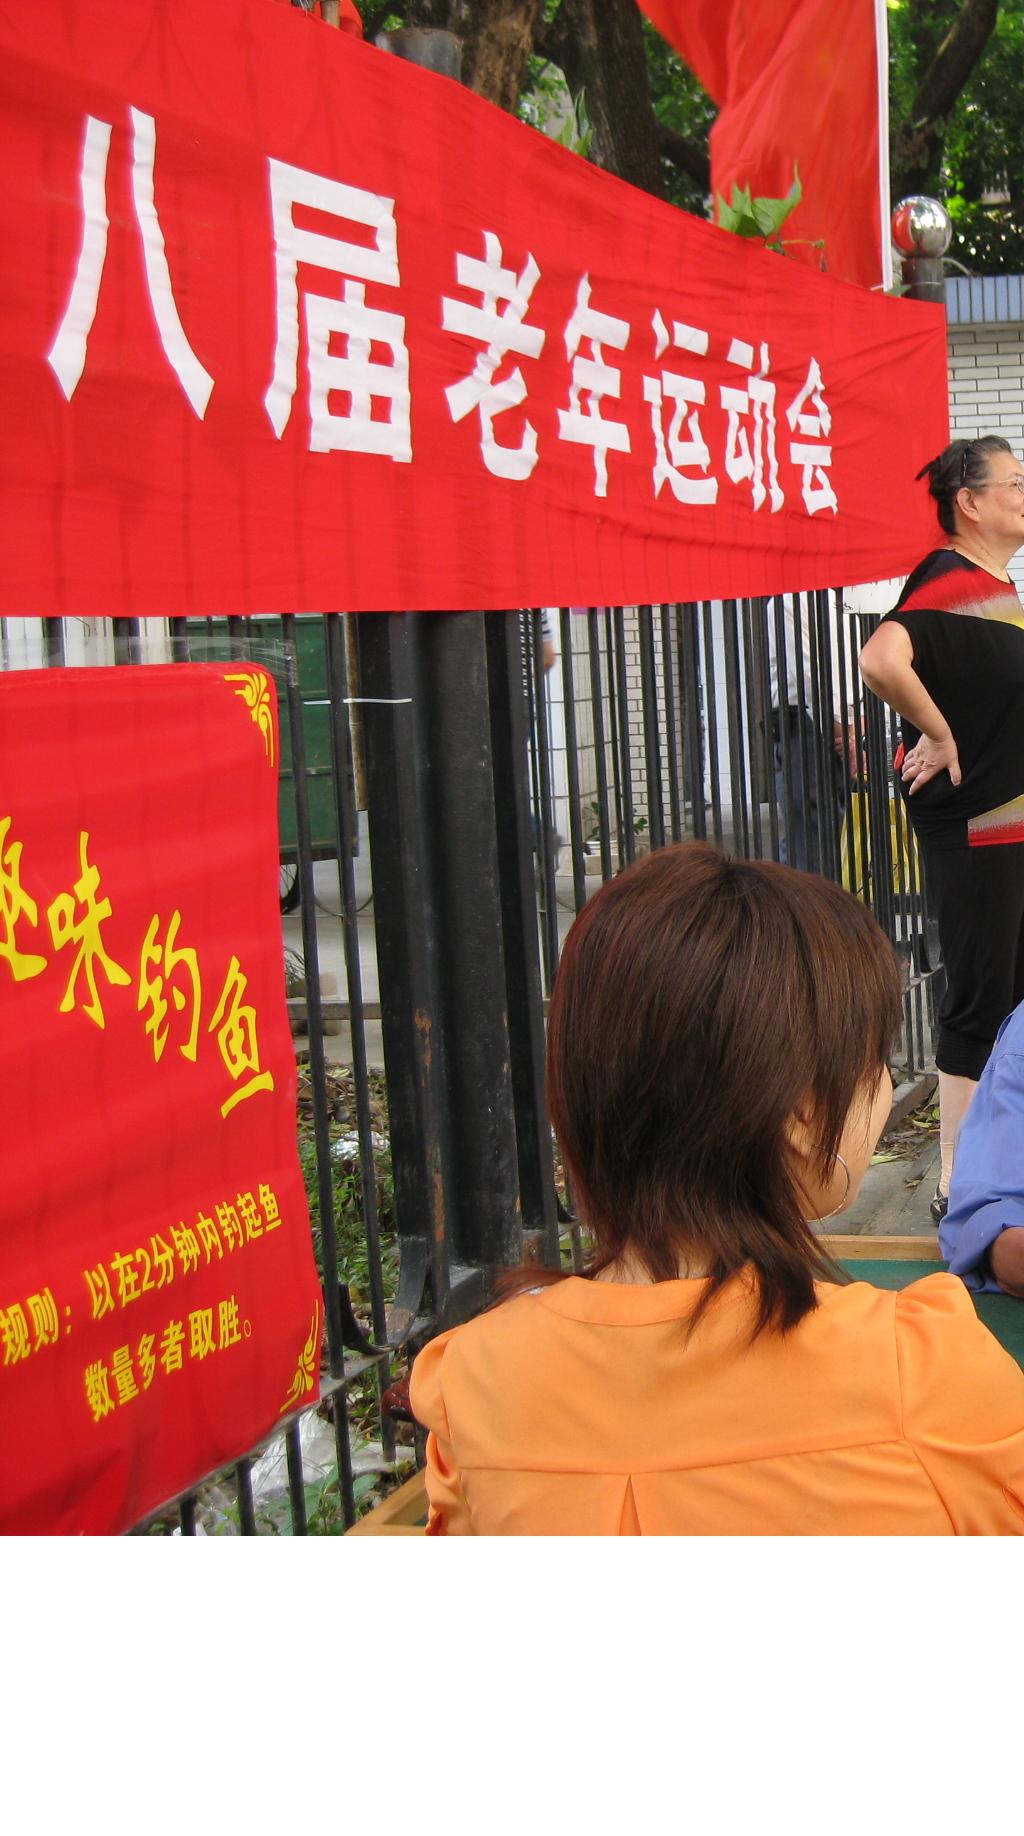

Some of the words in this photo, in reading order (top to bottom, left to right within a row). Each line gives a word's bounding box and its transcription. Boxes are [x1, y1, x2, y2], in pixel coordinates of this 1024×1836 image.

[48, 105, 839, 516] 八届老年运动会
